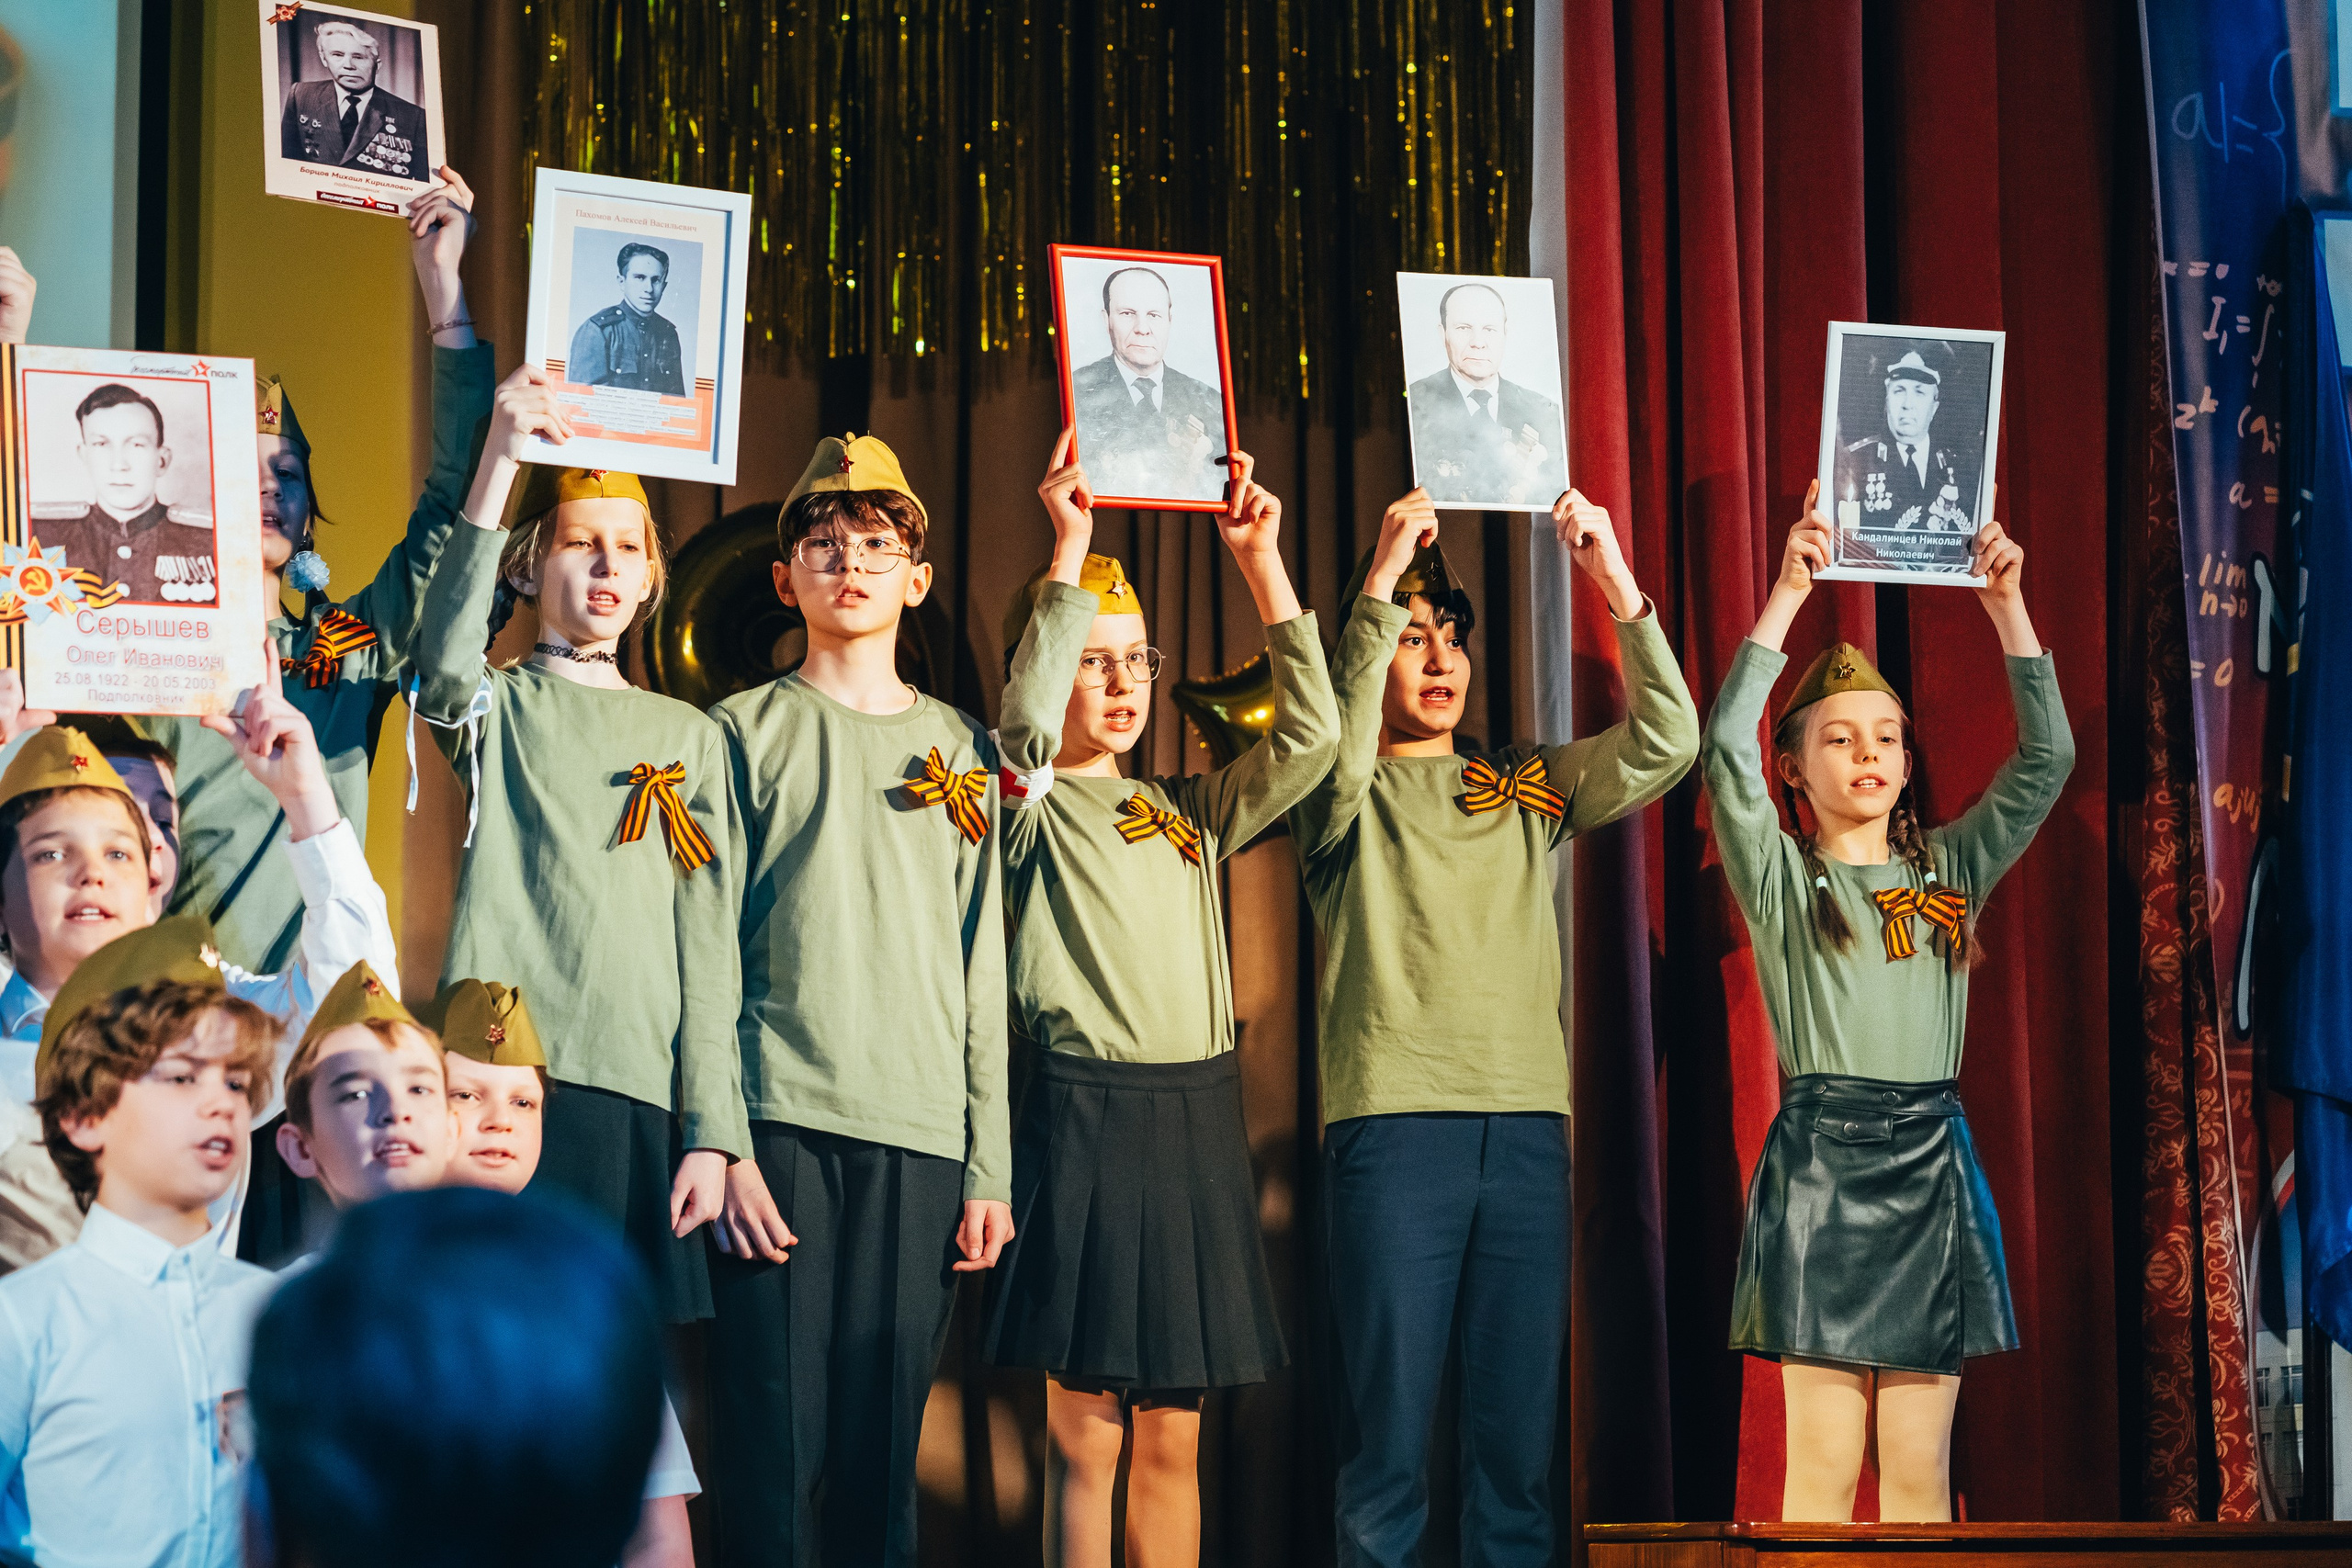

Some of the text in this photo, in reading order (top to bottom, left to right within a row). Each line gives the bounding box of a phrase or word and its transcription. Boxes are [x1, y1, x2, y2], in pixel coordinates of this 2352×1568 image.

[300, 166, 413, 191] Борцов Михаил Кириллович
[575, 209, 697, 232] Пахомов Алексей Васильевич
[1851, 531, 1962, 547] Кандалинцев Николай
[1875, 547, 1935, 560] Николаевич
[76, 609, 210, 641] Серышев
[66, 645, 224, 670] Олег Иванович
[88, 689, 186, 704] Подполковник
